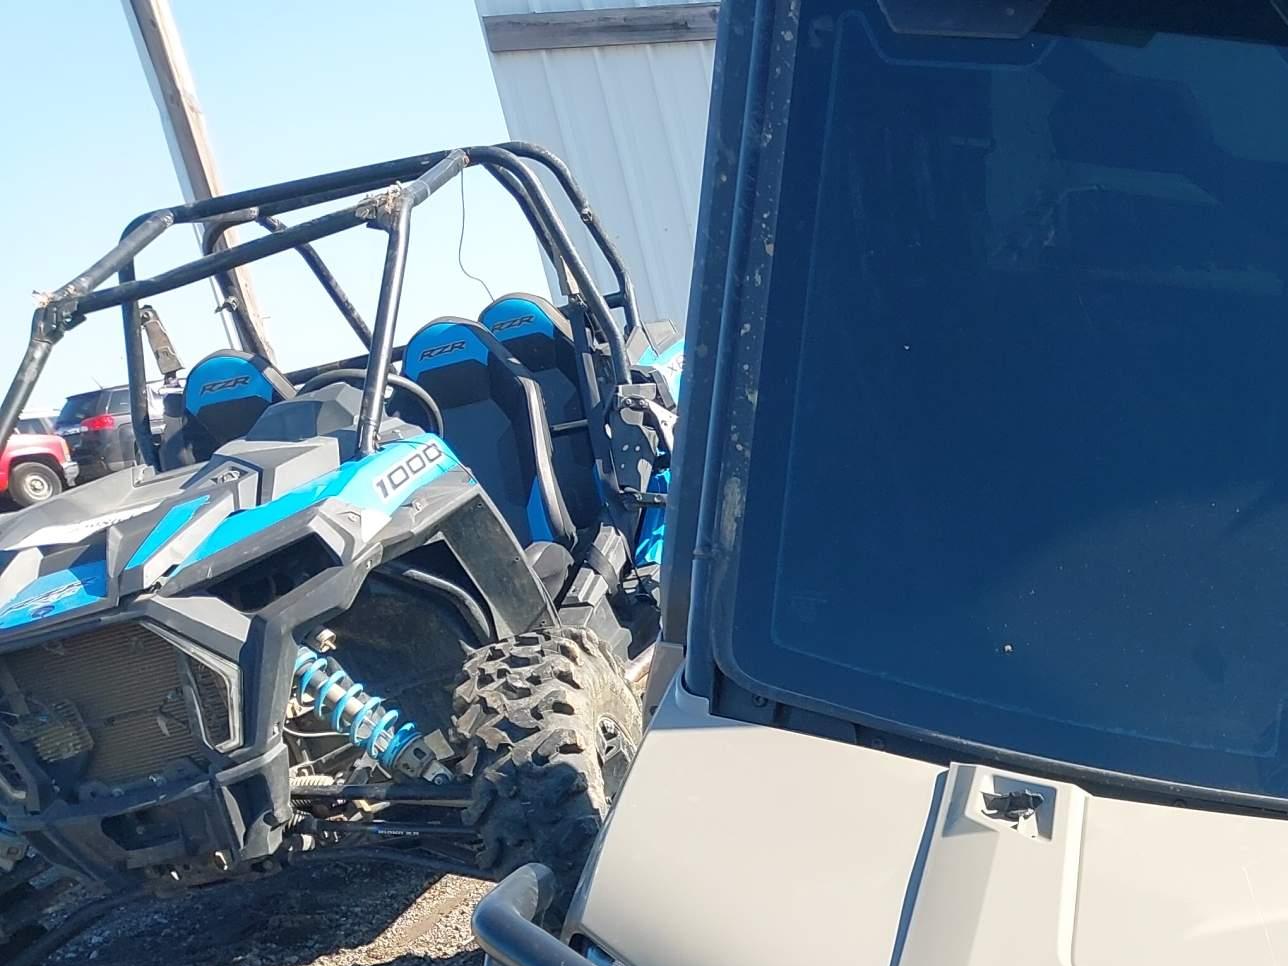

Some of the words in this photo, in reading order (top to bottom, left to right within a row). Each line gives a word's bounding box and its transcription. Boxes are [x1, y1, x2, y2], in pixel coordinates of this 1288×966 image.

[491, 314, 535, 333] RZR
[419, 340, 466, 361] RZR
[200, 375, 251, 396] RZR
[376, 443, 442, 499] 1000
